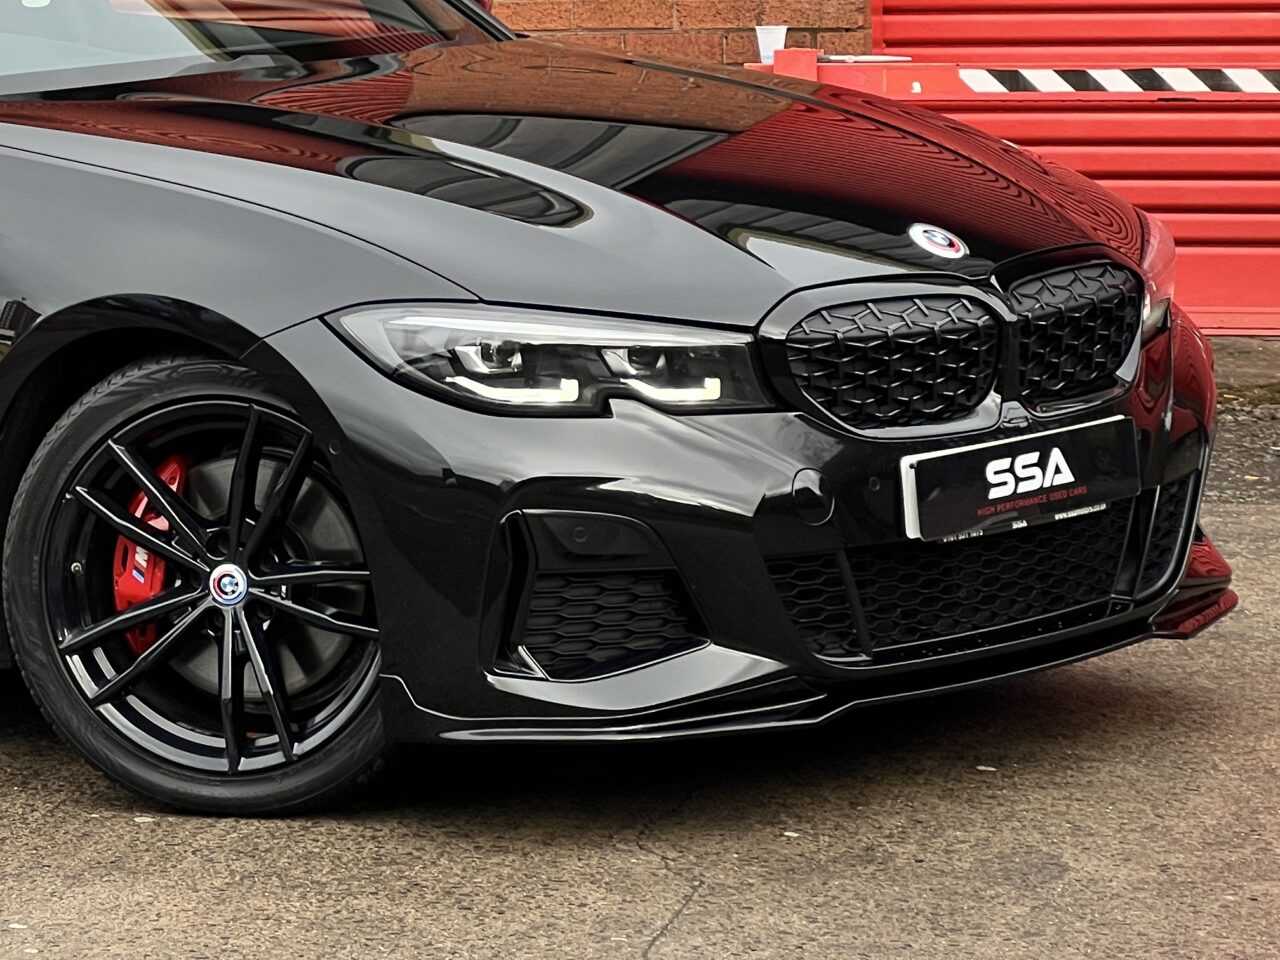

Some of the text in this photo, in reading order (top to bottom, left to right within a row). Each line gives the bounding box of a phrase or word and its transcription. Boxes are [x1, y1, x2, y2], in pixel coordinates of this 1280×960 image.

[985, 447, 1075, 499] SSA
[977, 486, 1087, 516] HIGH PERFORMANCE USED CARS
